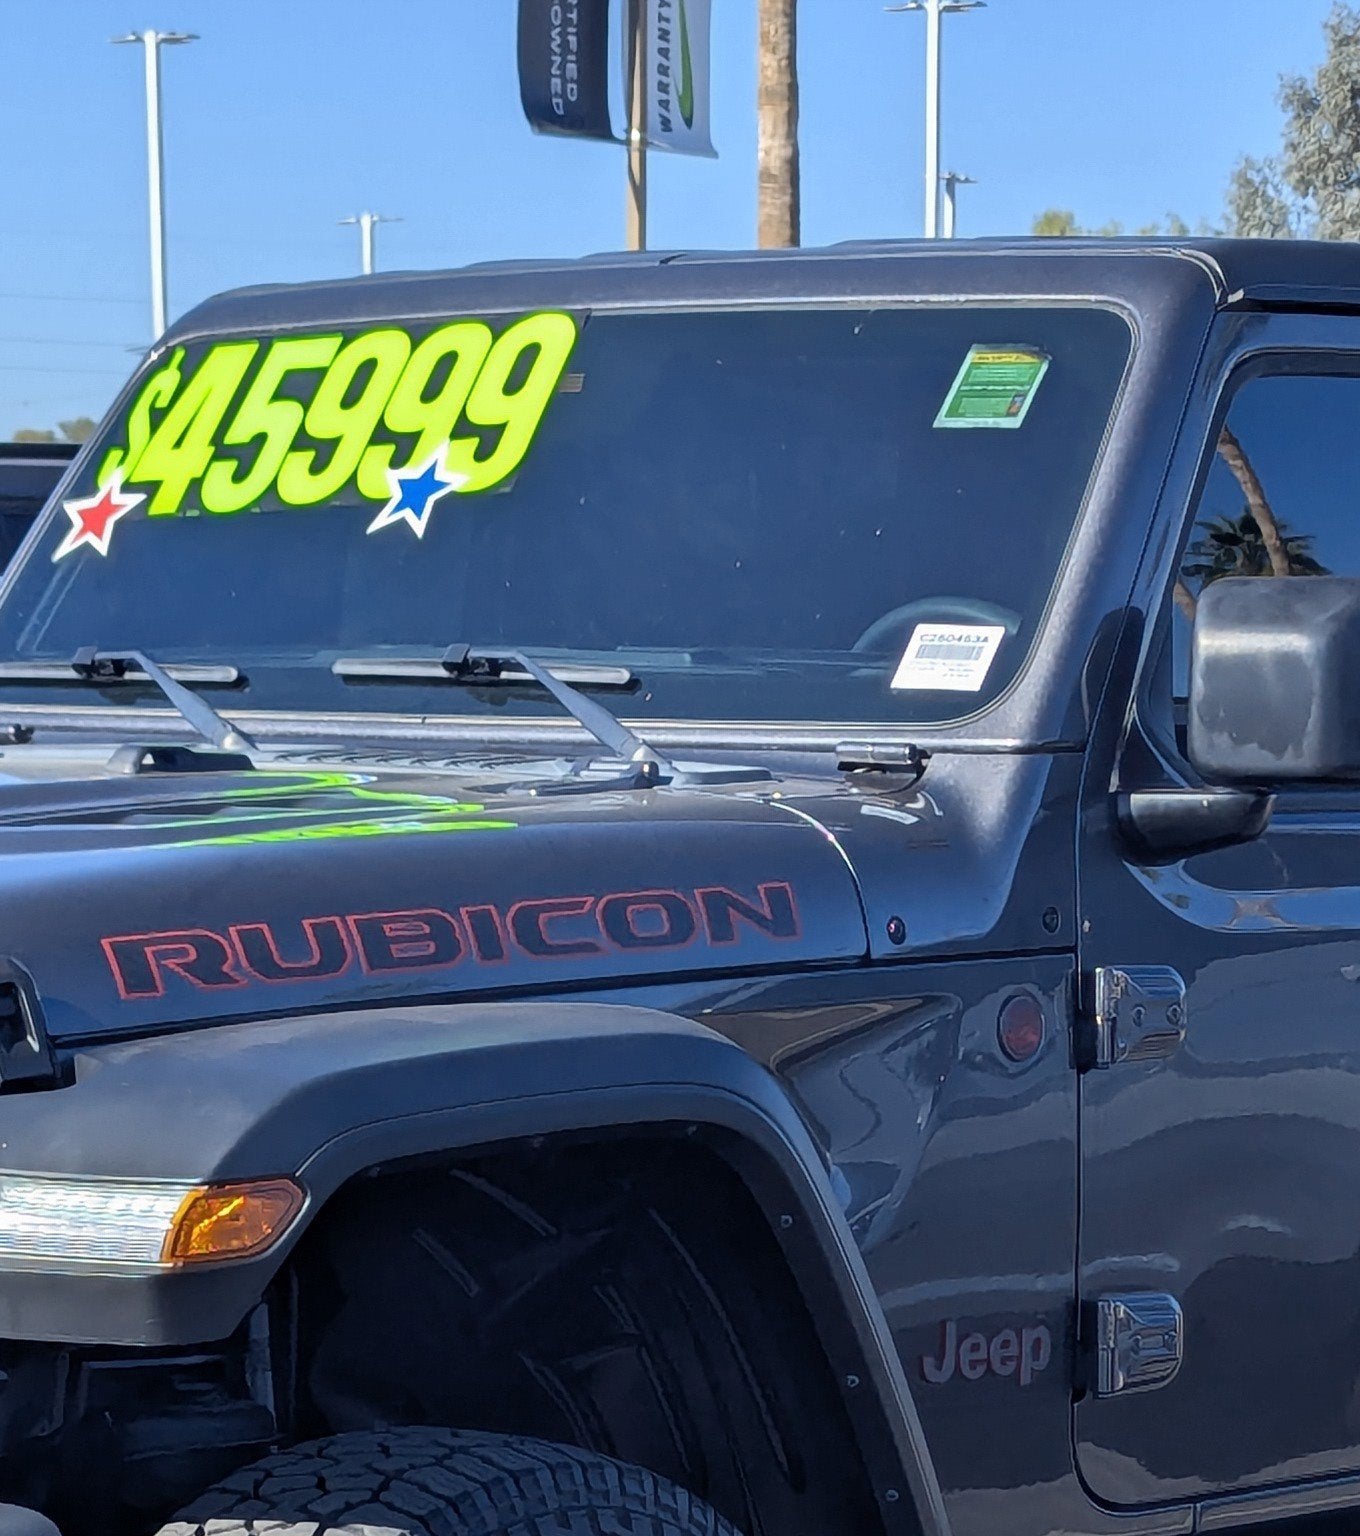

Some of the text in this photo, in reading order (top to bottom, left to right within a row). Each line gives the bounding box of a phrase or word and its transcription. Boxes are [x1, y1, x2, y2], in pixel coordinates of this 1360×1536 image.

[657, 0, 672, 133] WARRANTY
[96, 311, 577, 517] $45999
[100, 880, 802, 1000] RUBICON
[920, 1321, 1052, 1386] Jeep
